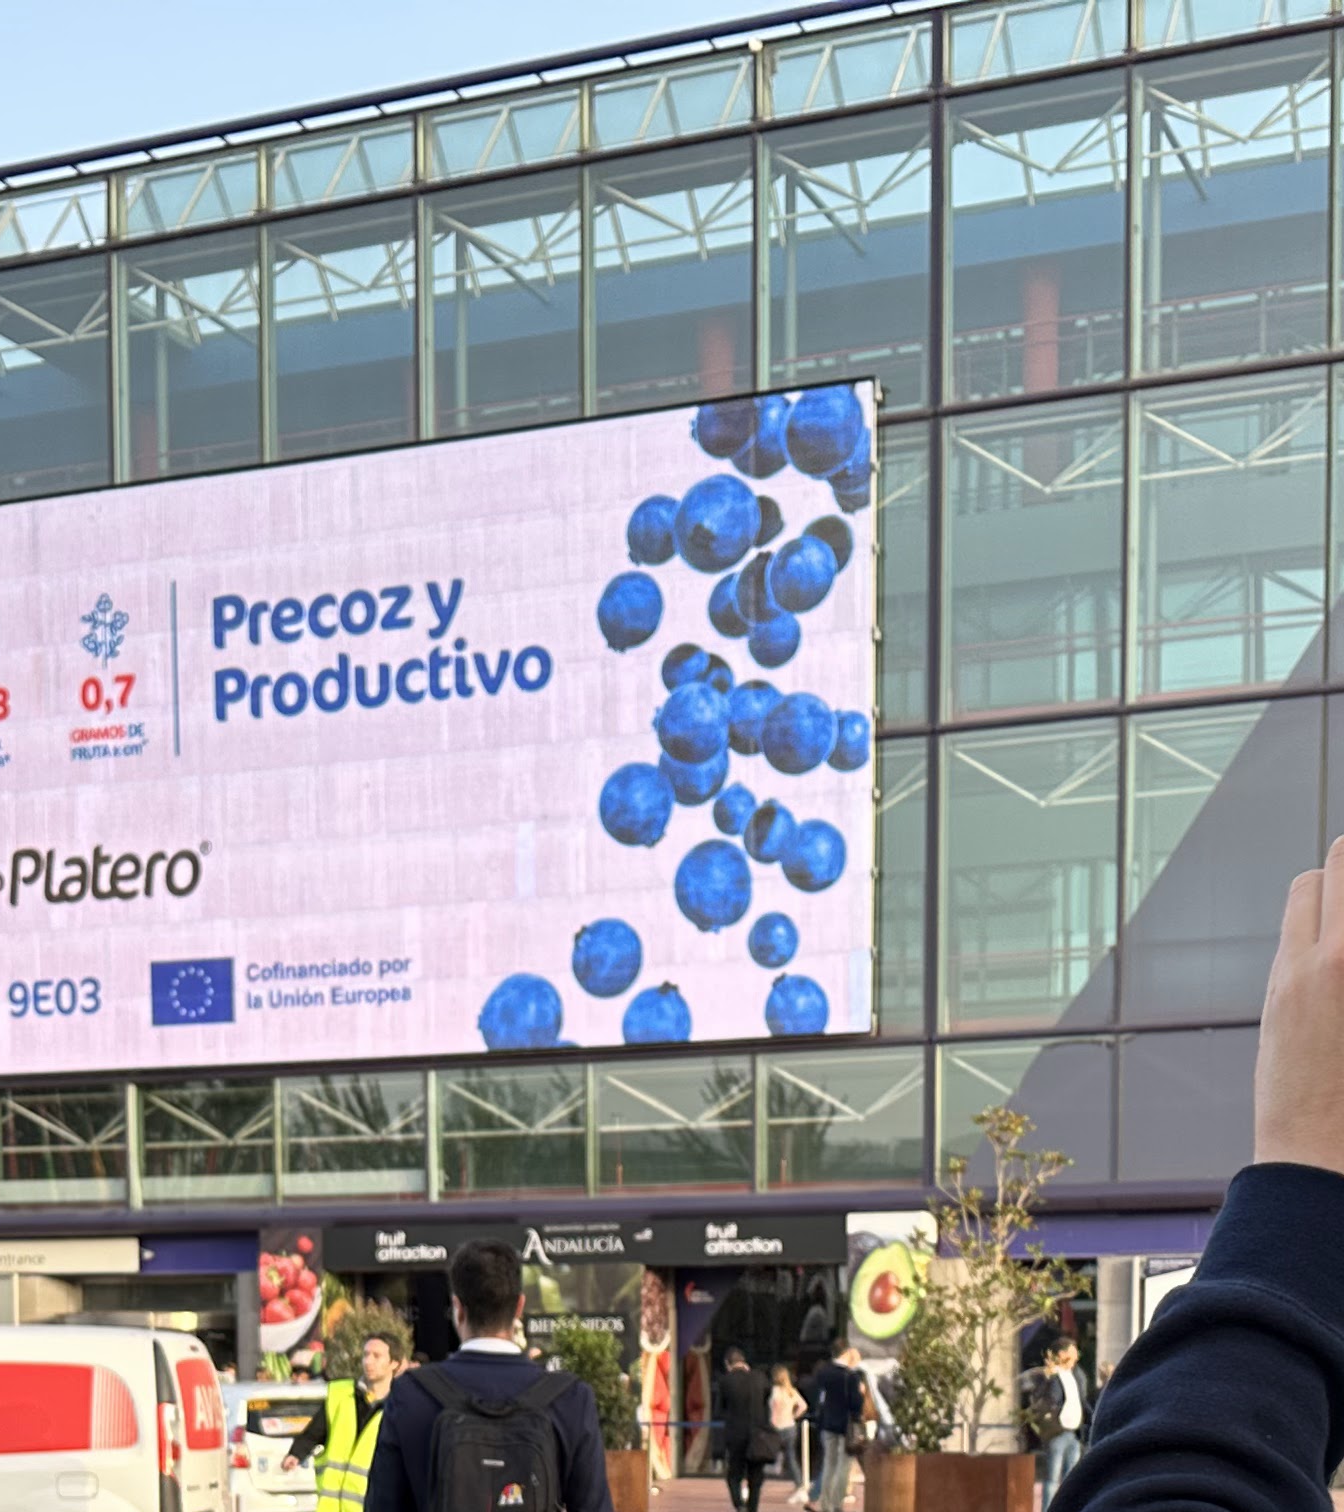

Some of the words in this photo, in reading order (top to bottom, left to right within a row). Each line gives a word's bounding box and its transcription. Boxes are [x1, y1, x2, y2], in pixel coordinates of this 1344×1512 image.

[212, 583, 416, 650] Precoz
[425, 577, 464, 640] y
[80, 673, 137, 715] 0,7
[214, 636, 553, 723] Productivo
[247, 958, 373, 983] Cofinanciado
[379, 956, 412, 979] por
[8, 976, 102, 1017] 9E03
[247, 991, 264, 1010] la
[268, 985, 325, 1008] Unión
[331, 983, 412, 1007] Europea
